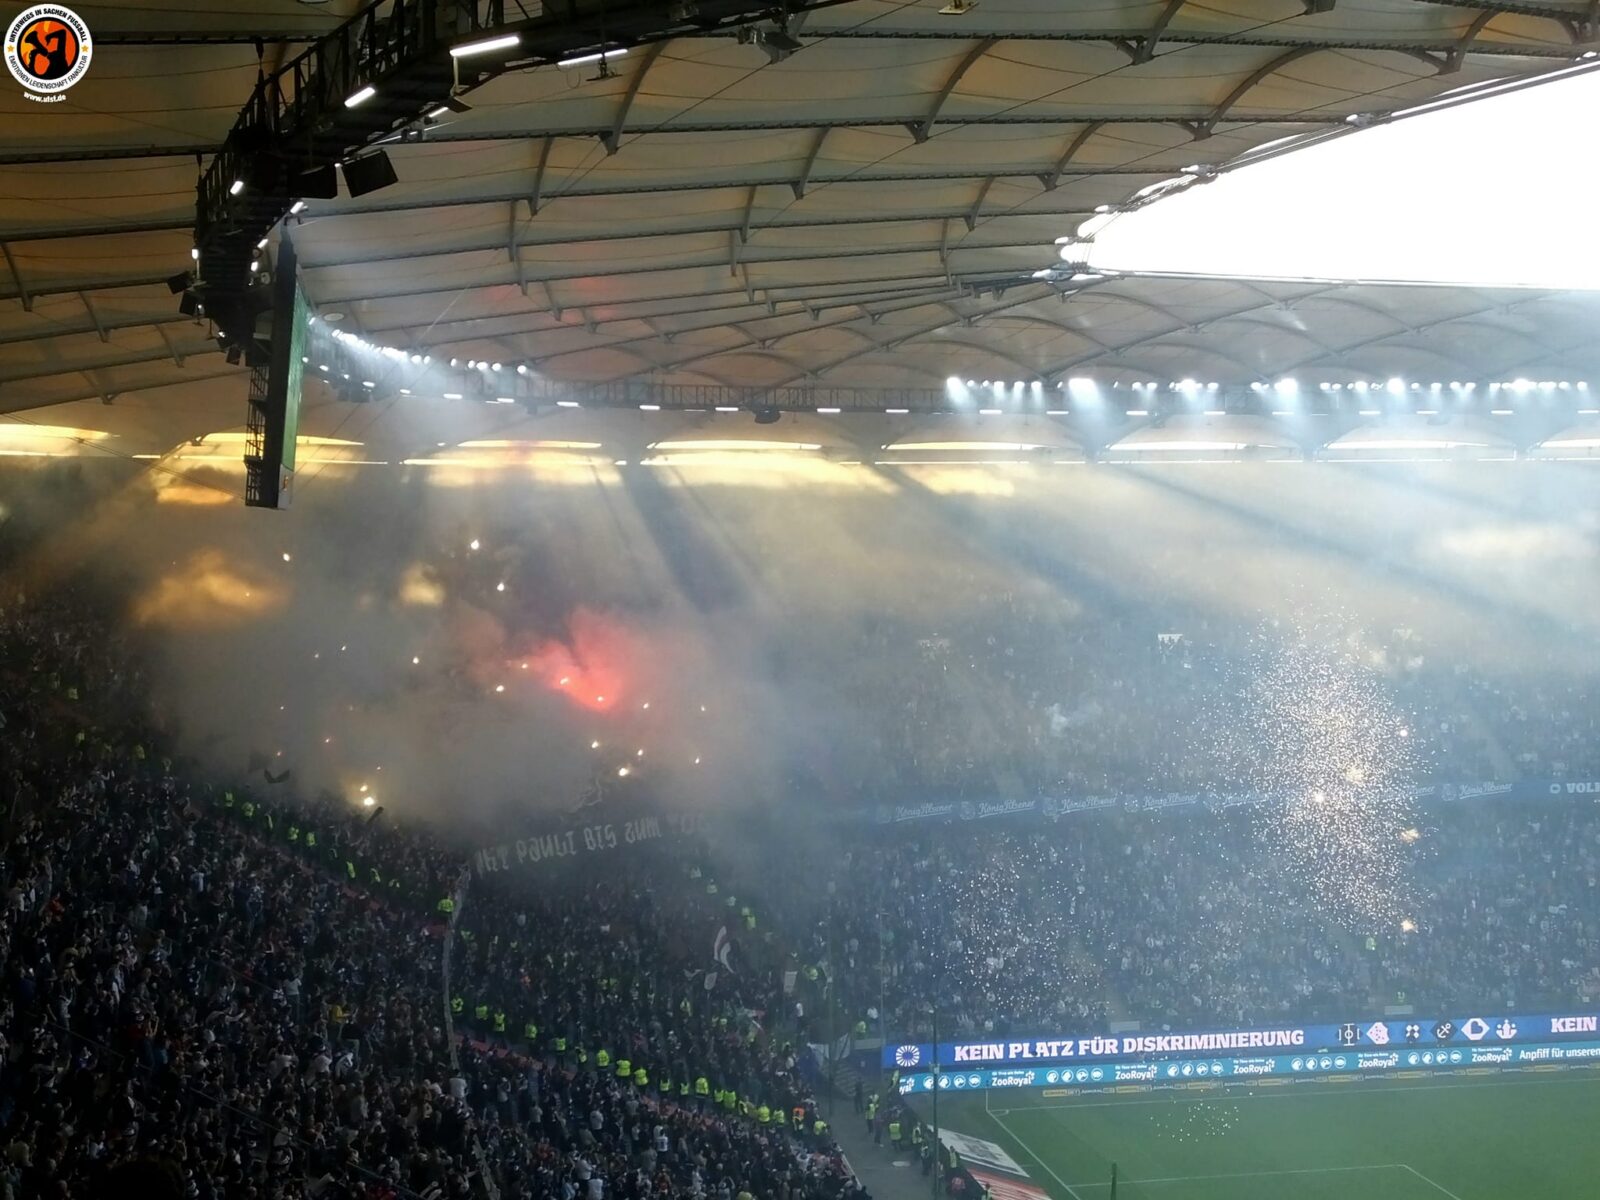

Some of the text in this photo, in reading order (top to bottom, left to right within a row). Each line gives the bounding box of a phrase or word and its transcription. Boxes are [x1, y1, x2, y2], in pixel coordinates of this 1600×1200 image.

[583, 824, 617, 851] BIS
[1550, 1016, 1598, 1033] KEIN
[954, 1030, 1304, 1062] KEIN PLATZ FÜR DISKRIMINIERUNG
[1471, 1052, 1510, 1063] ZooRoyal
[1519, 1048, 1549, 1061] Anpfiff
[1551, 1047, 1565, 1058] für
[1358, 1058, 1396, 1068] ZooRoyal
[1115, 1069, 1154, 1080] ZooRoyal
[1233, 1064, 1272, 1075] ZooRoyal
[992, 1076, 1032, 1087] ZooRoyal
